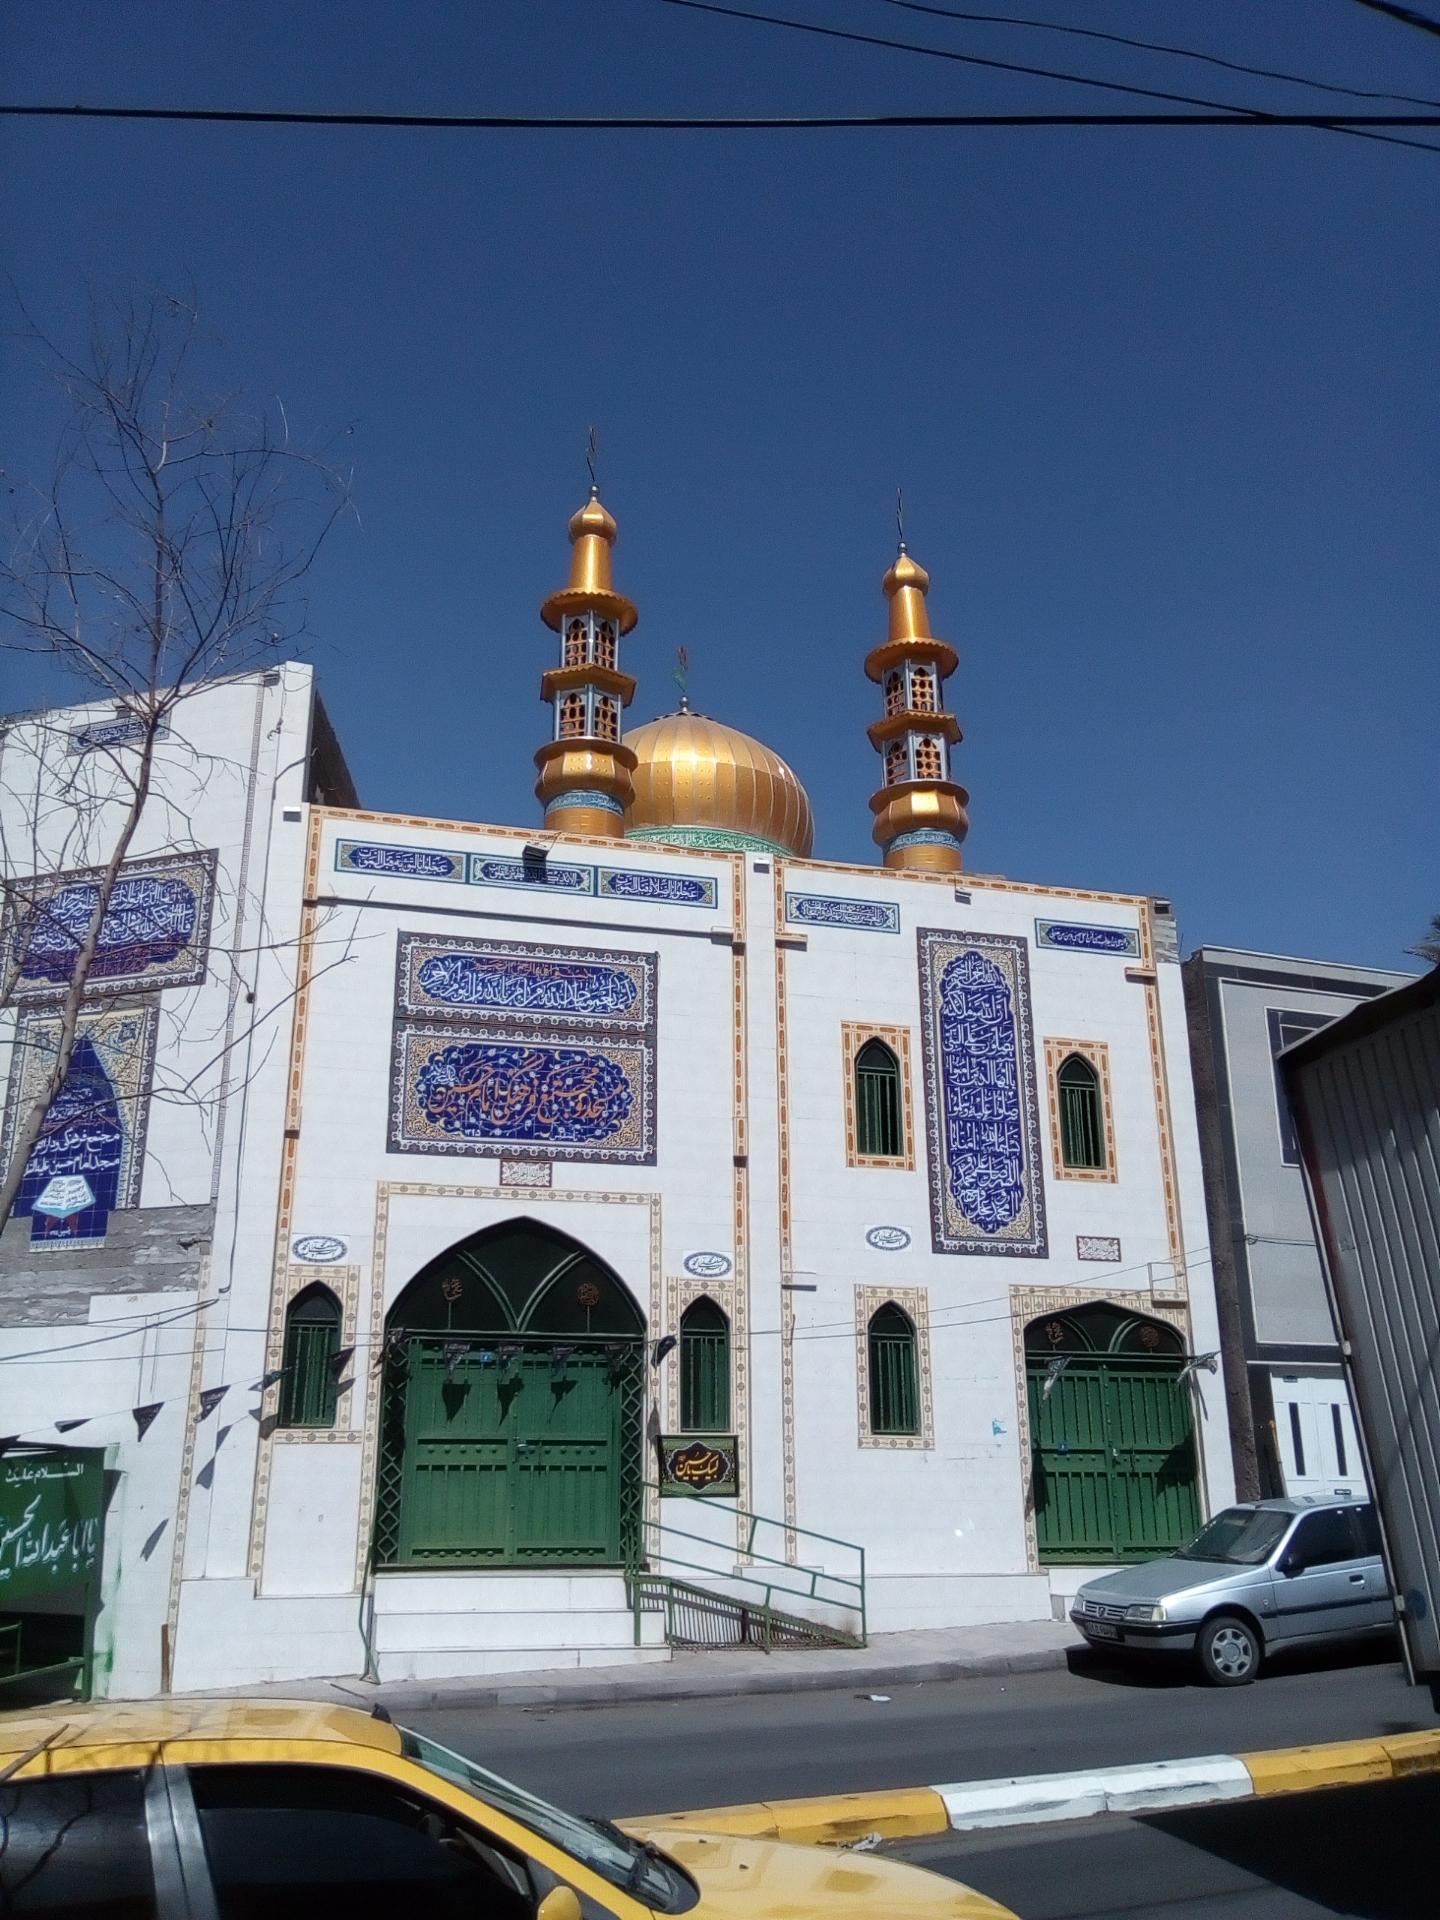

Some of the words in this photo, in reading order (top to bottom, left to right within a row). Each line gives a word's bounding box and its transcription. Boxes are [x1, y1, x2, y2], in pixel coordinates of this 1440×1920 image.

[86, 1130, 121, 1152] مجتمع
[49, 1158, 74, 1176] حسین
[90, 1154, 120, 1172] مسجد
[4, 1463, 34, 1488] علیک
[33, 1462, 85, 1485] السلام
[675, 1451, 713, 1480] حسین
